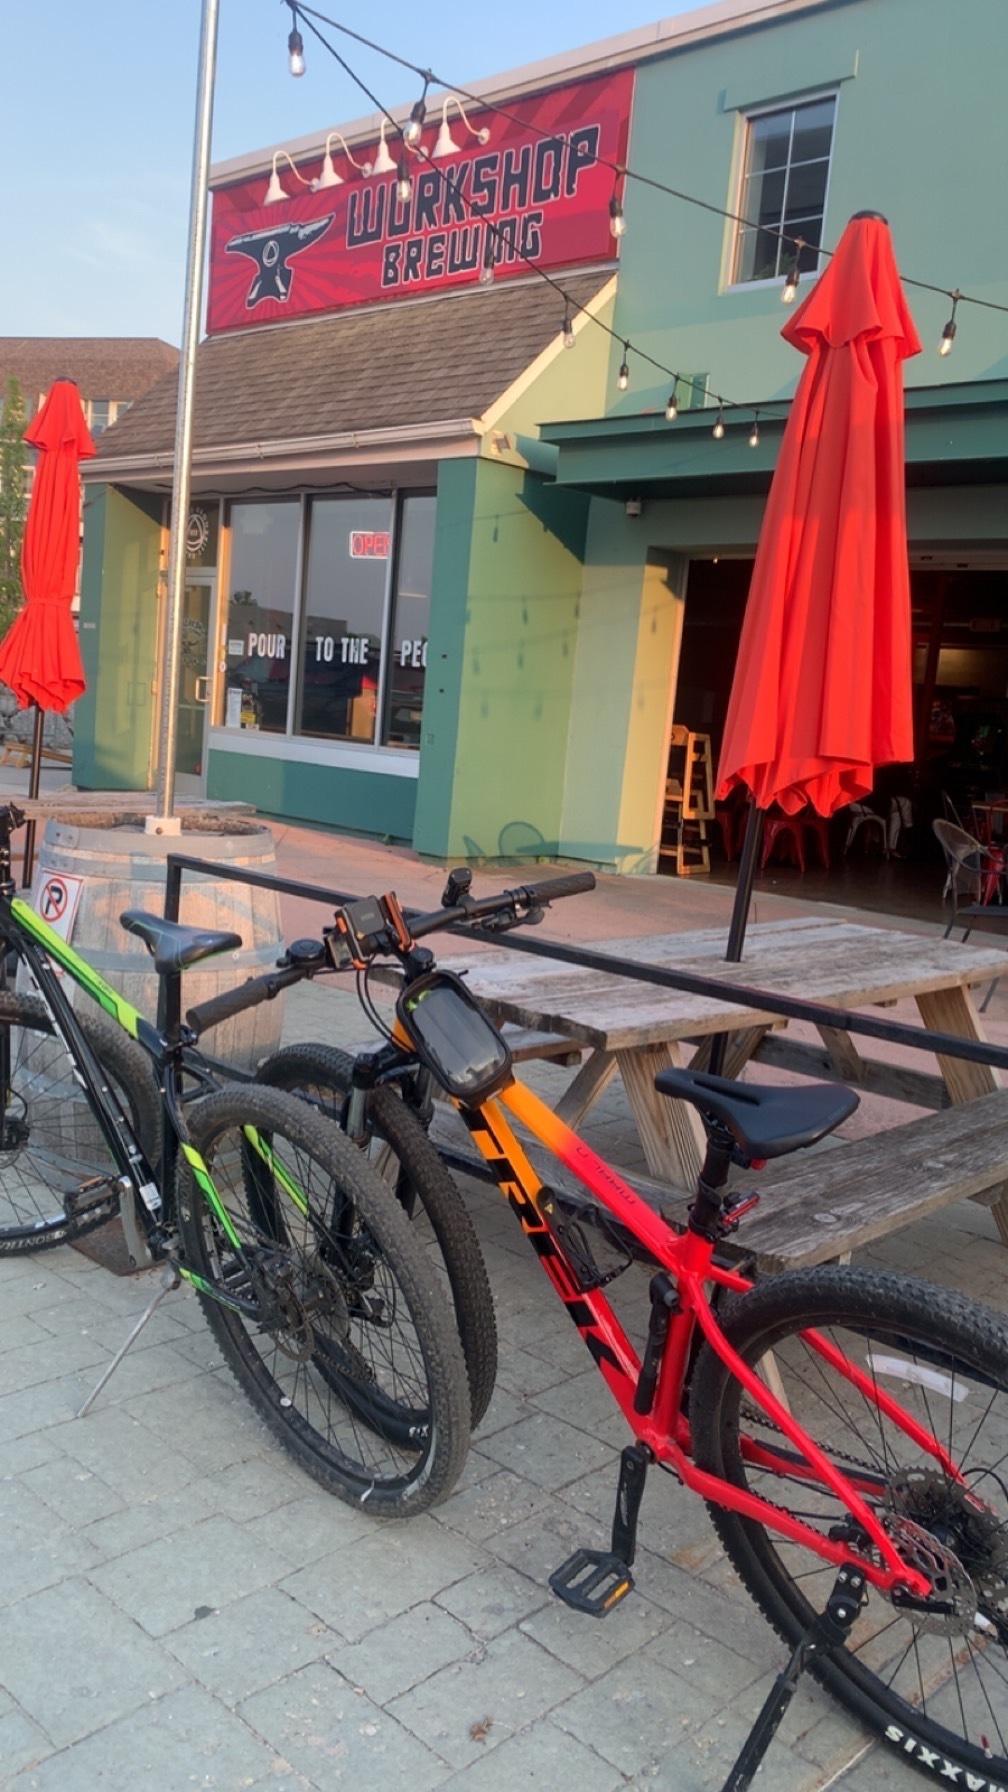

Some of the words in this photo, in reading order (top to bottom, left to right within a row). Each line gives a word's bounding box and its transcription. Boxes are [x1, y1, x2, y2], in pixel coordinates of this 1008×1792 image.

[346, 123, 600, 249] WORKSHOP
[381, 209, 544, 288] BREWING
[248, 632, 286, 659] POUR
[315, 636, 335, 662] TO
[340, 637, 369, 664] THE
